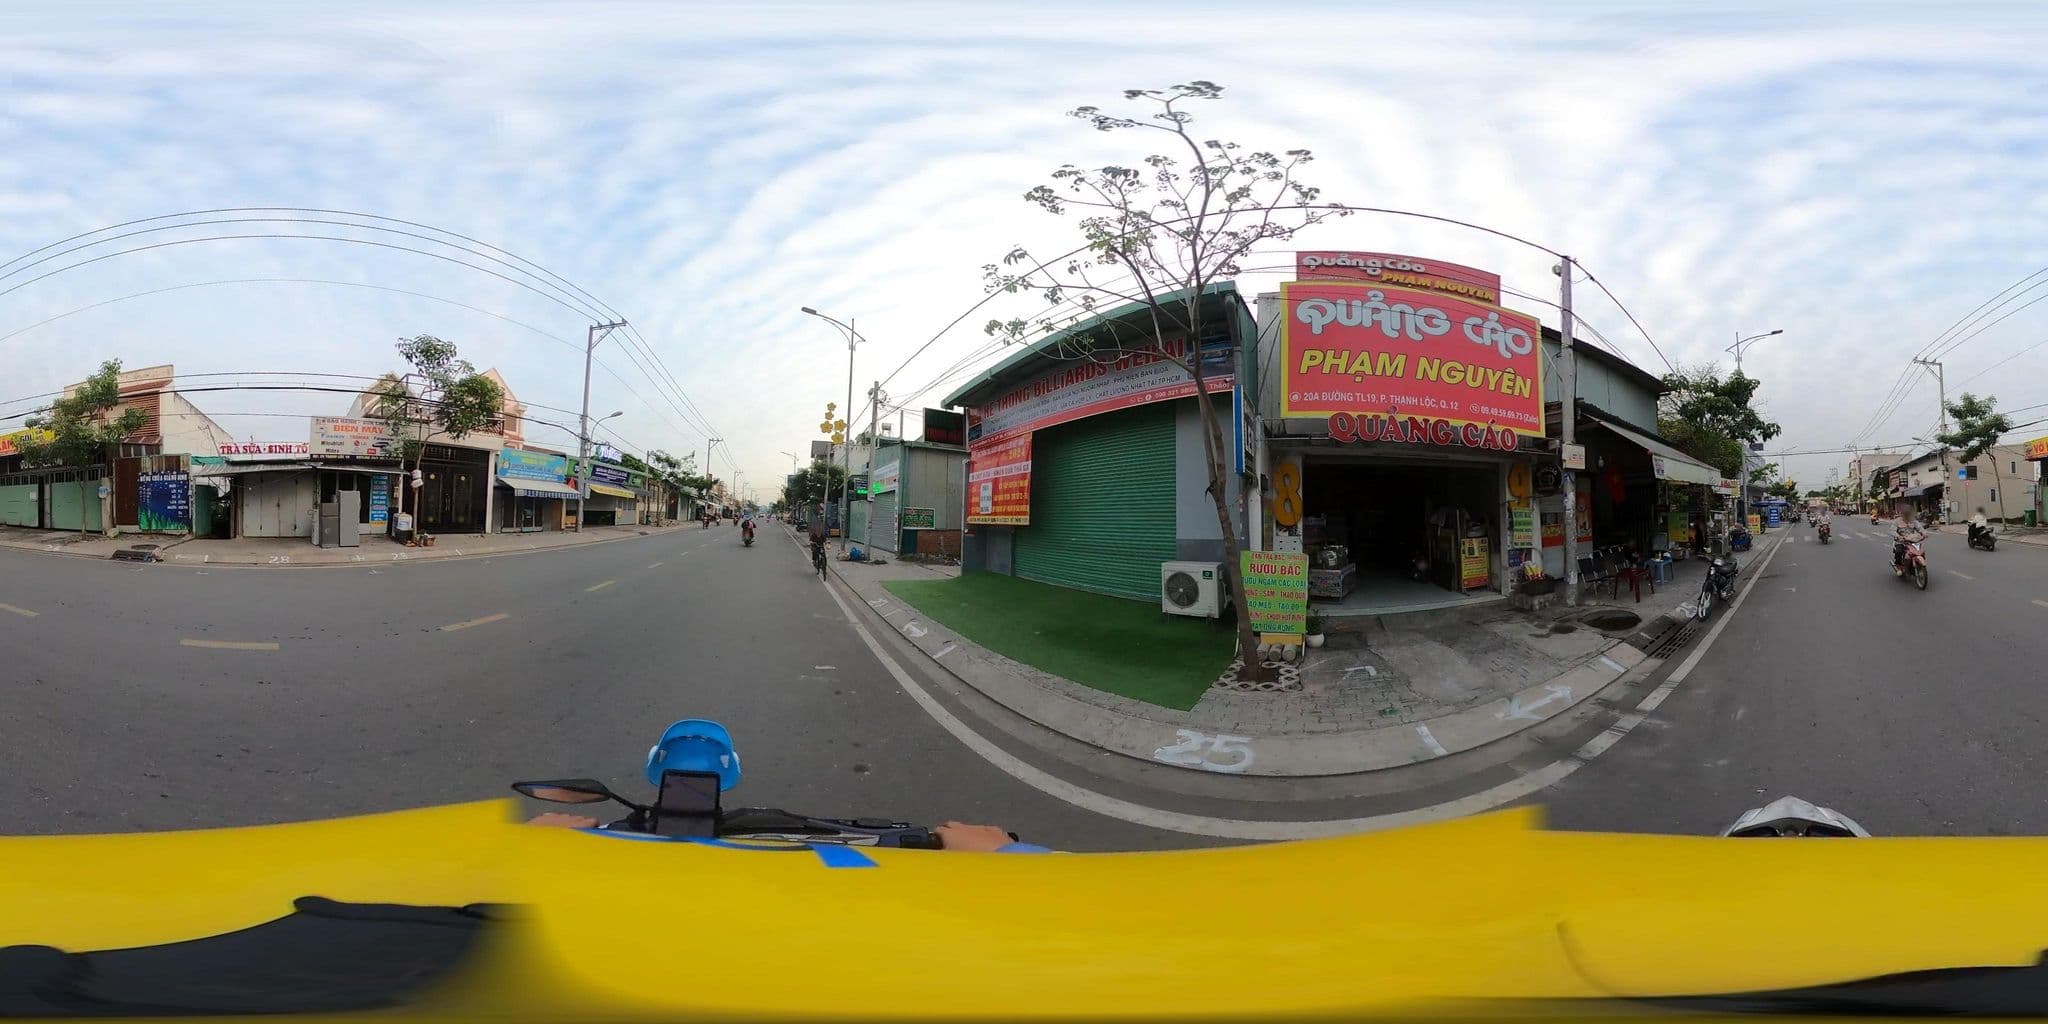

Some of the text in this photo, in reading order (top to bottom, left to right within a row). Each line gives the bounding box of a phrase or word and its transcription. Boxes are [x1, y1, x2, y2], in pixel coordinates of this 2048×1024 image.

[1296, 290, 1533, 358] QUẢNG CÁO
[1299, 349, 1532, 398] PHẠM NGUYÊN
[1304, 392, 1319, 401] 20A
[1321, 389, 1353, 402] ĐƯỜNG
[1450, 401, 1459, 410] 12
[219, 442, 240, 455] TRÀ
[1328, 405, 1518, 452] QUẢNG CÁO
[1274, 463, 1302, 526] 8
[1154, 728, 1254, 775] 25
